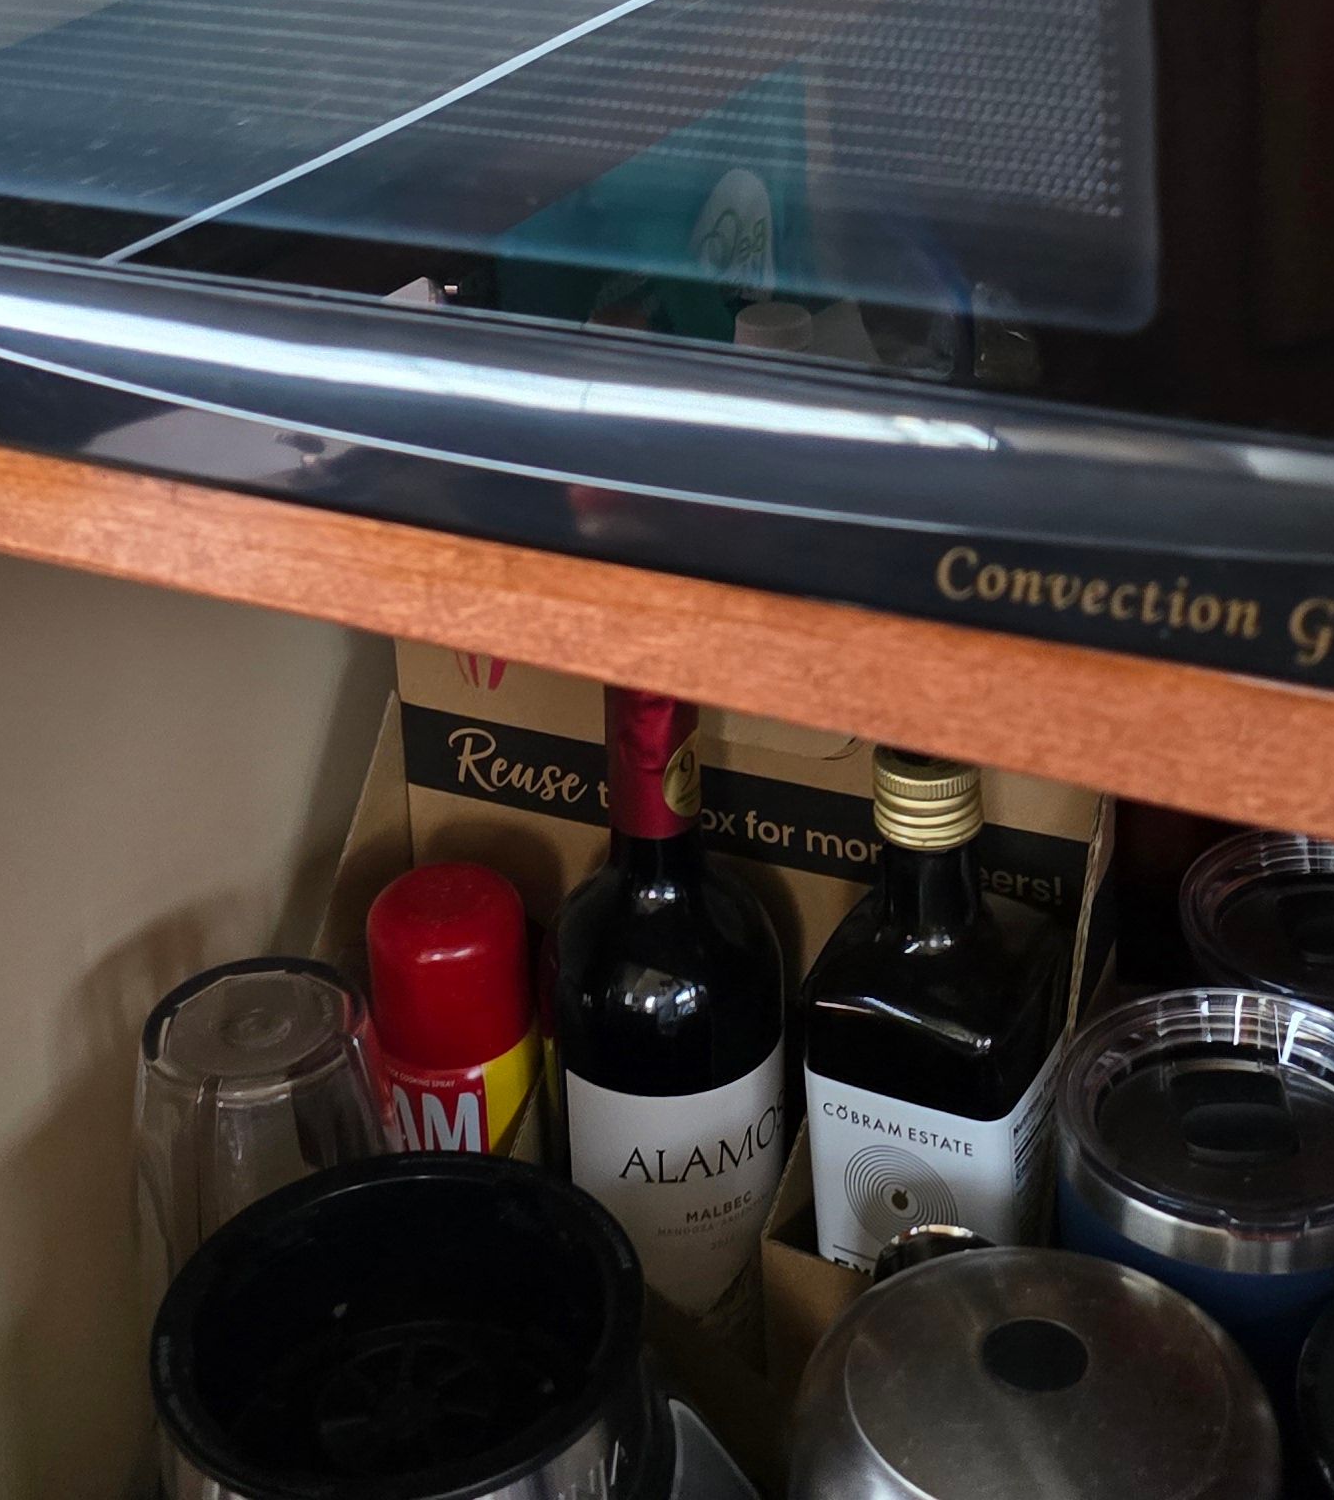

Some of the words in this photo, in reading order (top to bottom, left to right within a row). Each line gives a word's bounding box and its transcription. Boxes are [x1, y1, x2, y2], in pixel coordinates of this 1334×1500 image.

[934, 545, 1262, 640] Convection
[446, 727, 588, 806] Reuse
[700, 803, 738, 837] ox
[744, 808, 796, 849] for
[804, 821, 884, 866] mor
[383, 1083, 482, 1153] AM
[822, 1101, 903, 1138] COBRAM
[908, 1127, 974, 1157] ESTATE
[685, 1189, 753, 1224] MALBEC
